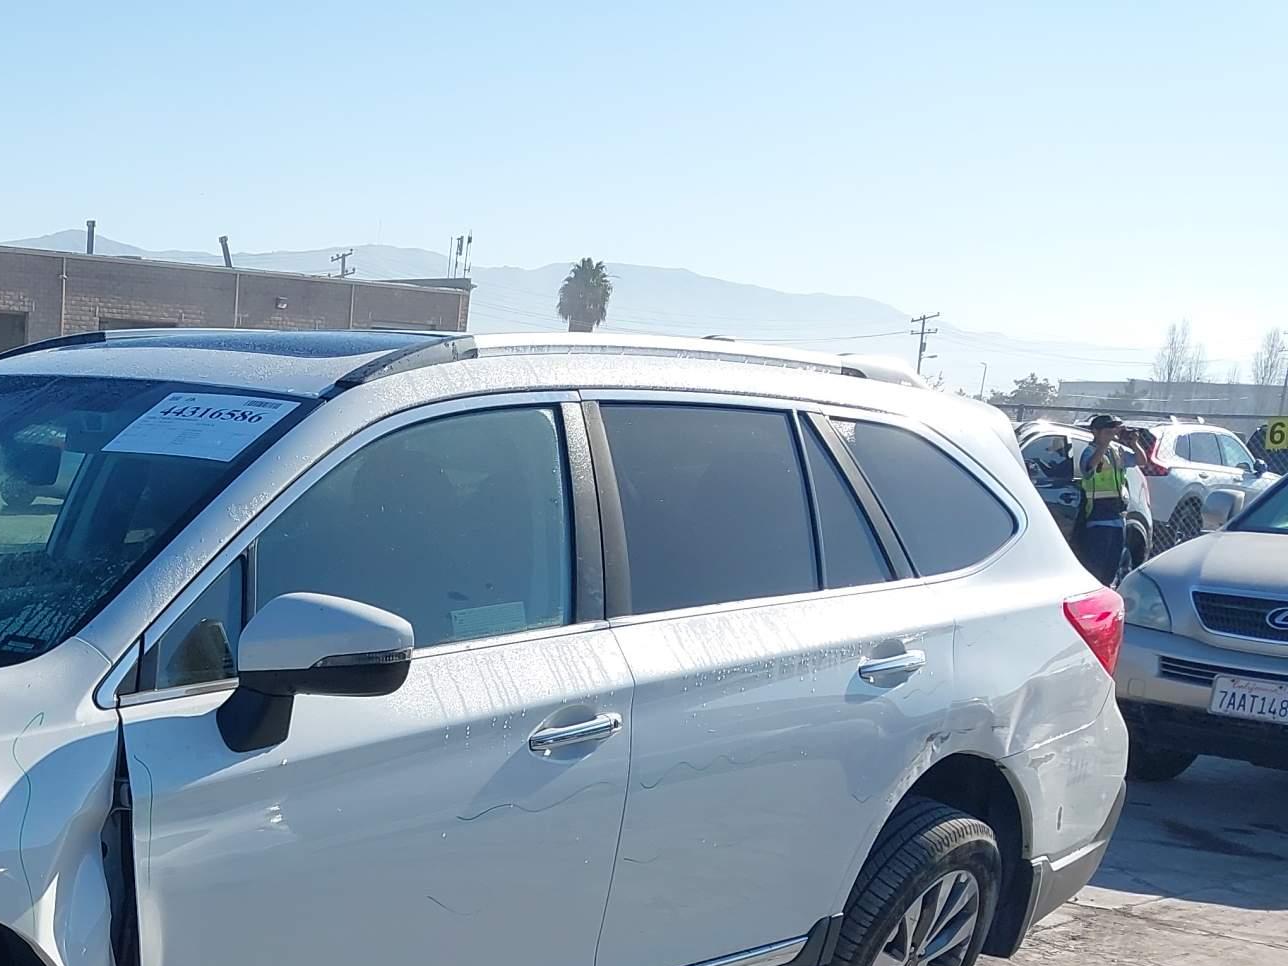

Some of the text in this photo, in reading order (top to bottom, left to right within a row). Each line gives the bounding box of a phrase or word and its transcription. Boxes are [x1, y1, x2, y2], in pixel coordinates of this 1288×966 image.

[160, 404, 269, 424] 44316586
[1269, 421, 1286, 445] 6
[1219, 690, 1288, 718] 7AAT148
